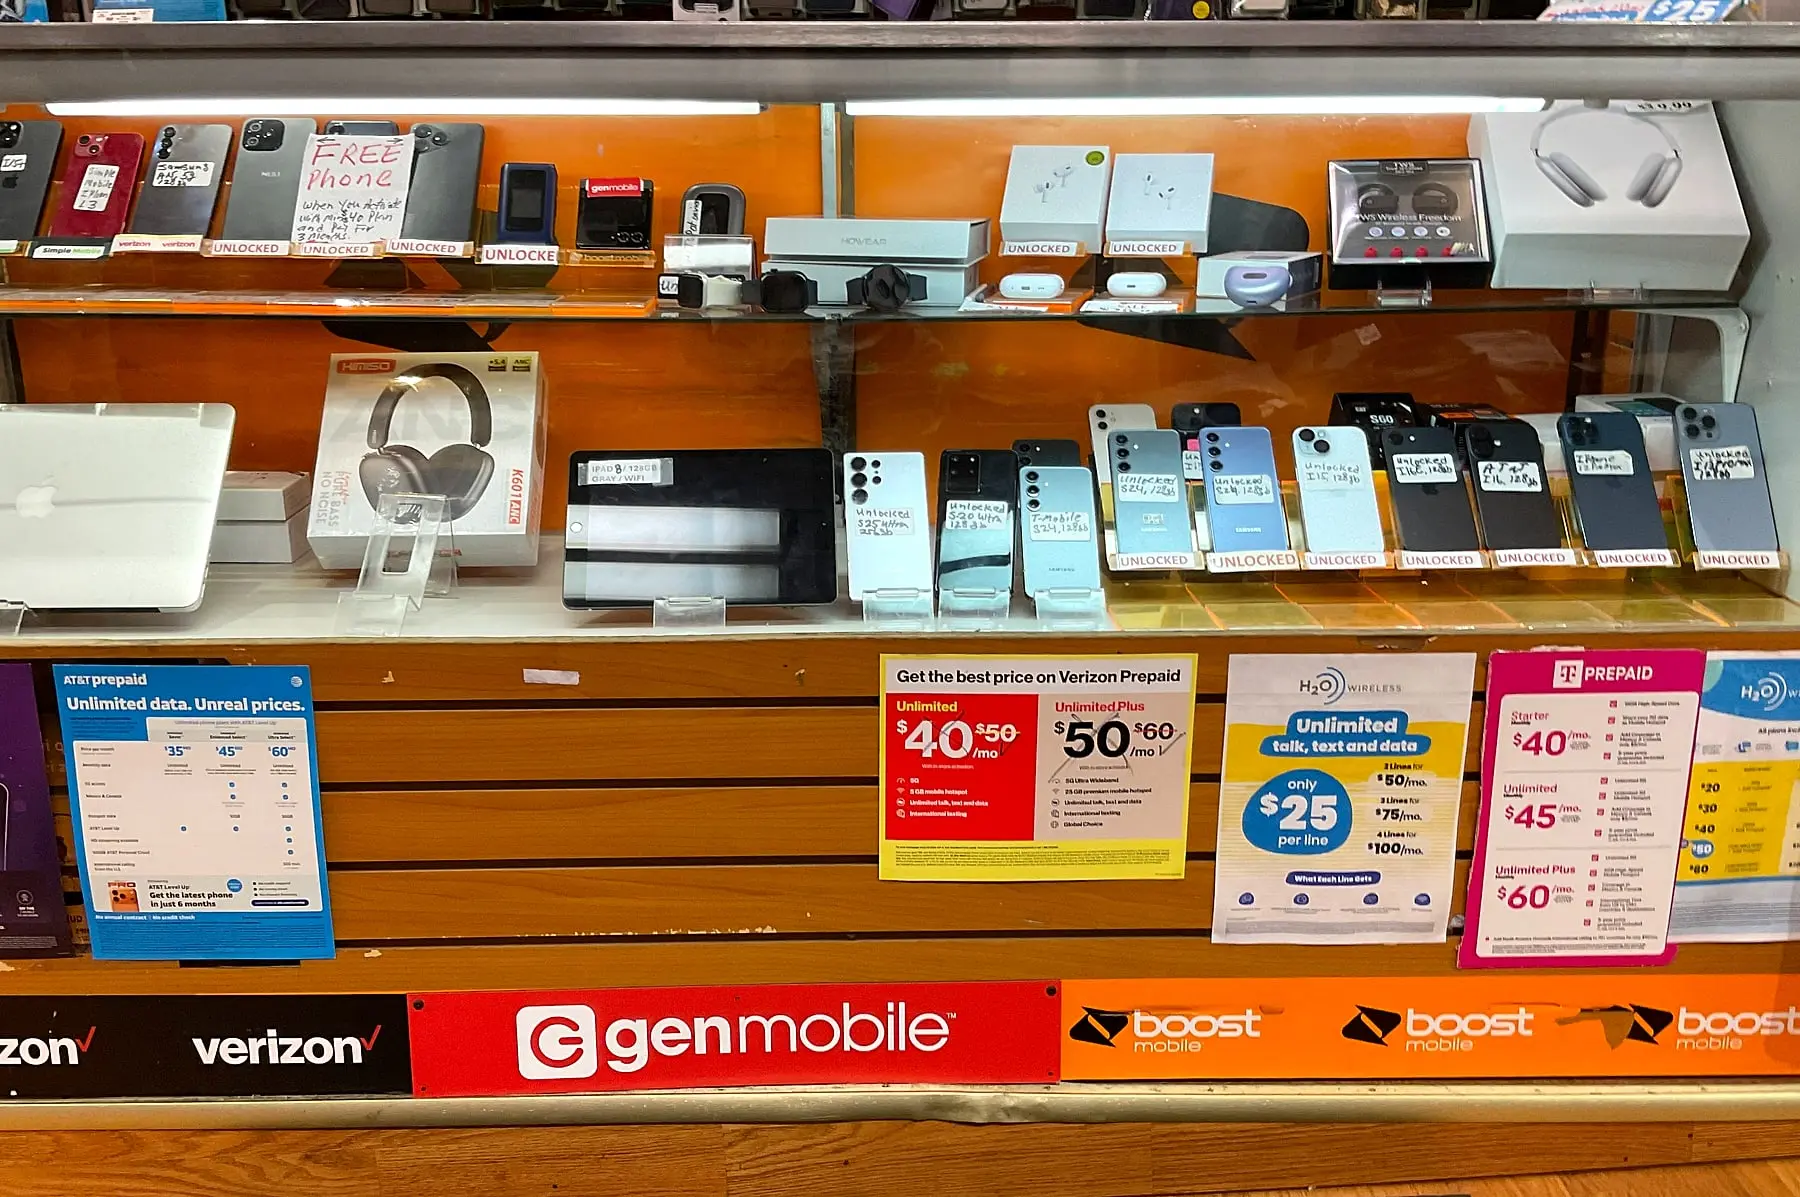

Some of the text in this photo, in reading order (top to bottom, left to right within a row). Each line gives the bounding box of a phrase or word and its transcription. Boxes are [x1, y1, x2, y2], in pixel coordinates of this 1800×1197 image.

[1654, 0, 1716, 21] $25
[312, 143, 404, 166] FREE
[592, 183, 638, 194] genmobile
[298, 233, 306, 241] 3
[162, 240, 196, 248] verizon
[214, 241, 279, 255] UNLOCKED
[391, 241, 456, 254] UNLOCKED
[1009, 244, 1070, 254] UNLOCKED
[1114, 244, 1177, 253] UNLOCKED
[42, 247, 72, 255] Simple
[304, 246, 368, 254] UNLOCKED
[486, 250, 555, 261] UNLOCKE
[1397, 456, 1448, 466] Unlocked
[629, 464, 657, 472] 128GB
[1305, 463, 1360, 472] Unlocked
[1120, 475, 1177, 485] Unlocked
[1215, 476, 1263, 485] Unlocked
[316, 472, 332, 524] NO NOISE
[510, 469, 524, 522] K601 ANC
[950, 502, 1006, 513] Unlocked
[328, 501, 341, 527] BASS
[857, 508, 911, 519] Unlocked
[1031, 512, 1082, 522] T-Mobile
[1120, 556, 1188, 566] UNLOCKED
[1213, 554, 1296, 568] UNLOCKED
[1308, 555, 1376, 565] UNLOCKED
[1406, 556, 1474, 565] UNLOCKED
[1499, 554, 1565, 564] UNLOCKED
[1599, 554, 1667, 564] UNLOCKED
[1703, 555, 1770, 564] UNLOCKED
[897, 670, 1181, 686] Get the best price on Verizon Prepaid
[1585, 666, 1653, 681] PREPAID
[1300, 680, 1402, 696] H2O WIRELESS
[1741, 684, 1773, 701] H2O
[67, 697, 305, 714] Unlimited data. Unreal prices.
[896, 701, 958, 712] Unlimited
[1056, 702, 1145, 712] Unlimited Plus
[1511, 712, 1549, 721] Starter
[1134, 722, 1174, 740] $60
[1296, 717, 1398, 734] Unlimited
[975, 723, 1017, 743] $50
[1568, 730, 1591, 739] /mo.
[896, 719, 974, 759] $40
[1054, 720, 1130, 758] $50
[1513, 730, 1567, 756] $40
[164, 746, 184, 756] $35
[216, 746, 235, 756] $45
[268, 746, 288, 757] $60
[1130, 746, 1155, 757] /mo
[1272, 740, 1417, 753] talk, text and data
[972, 748, 998, 758] /mo
[1288, 778, 1318, 792] only
[1377, 774, 1428, 788] $50/mo.
[1504, 784, 1557, 793] Unlimited
[1259, 792, 1338, 830] $25
[1559, 804, 1581, 813] /mo.
[1376, 809, 1422, 821] $75/mo.
[1504, 805, 1557, 829] $45
[1278, 834, 1328, 848] per line
[1368, 843, 1423, 856] $100/mo.
[1496, 865, 1575, 875] Unlimited Plus
[1552, 884, 1574, 894] /mo.
[208, 892, 233, 900] phone
[1497, 885, 1549, 909] $60
[1134, 1008, 1261, 1038] boost
[1407, 1007, 1534, 1036] boost
[1678, 1006, 1800, 1036] boost
[606, 1001, 949, 1073] genmobile
[192, 1029, 362, 1064] verizon
[1134, 1040, 1201, 1052] mobile
[1406, 1038, 1473, 1051] mobile
[1676, 1038, 1742, 1051] mobile
